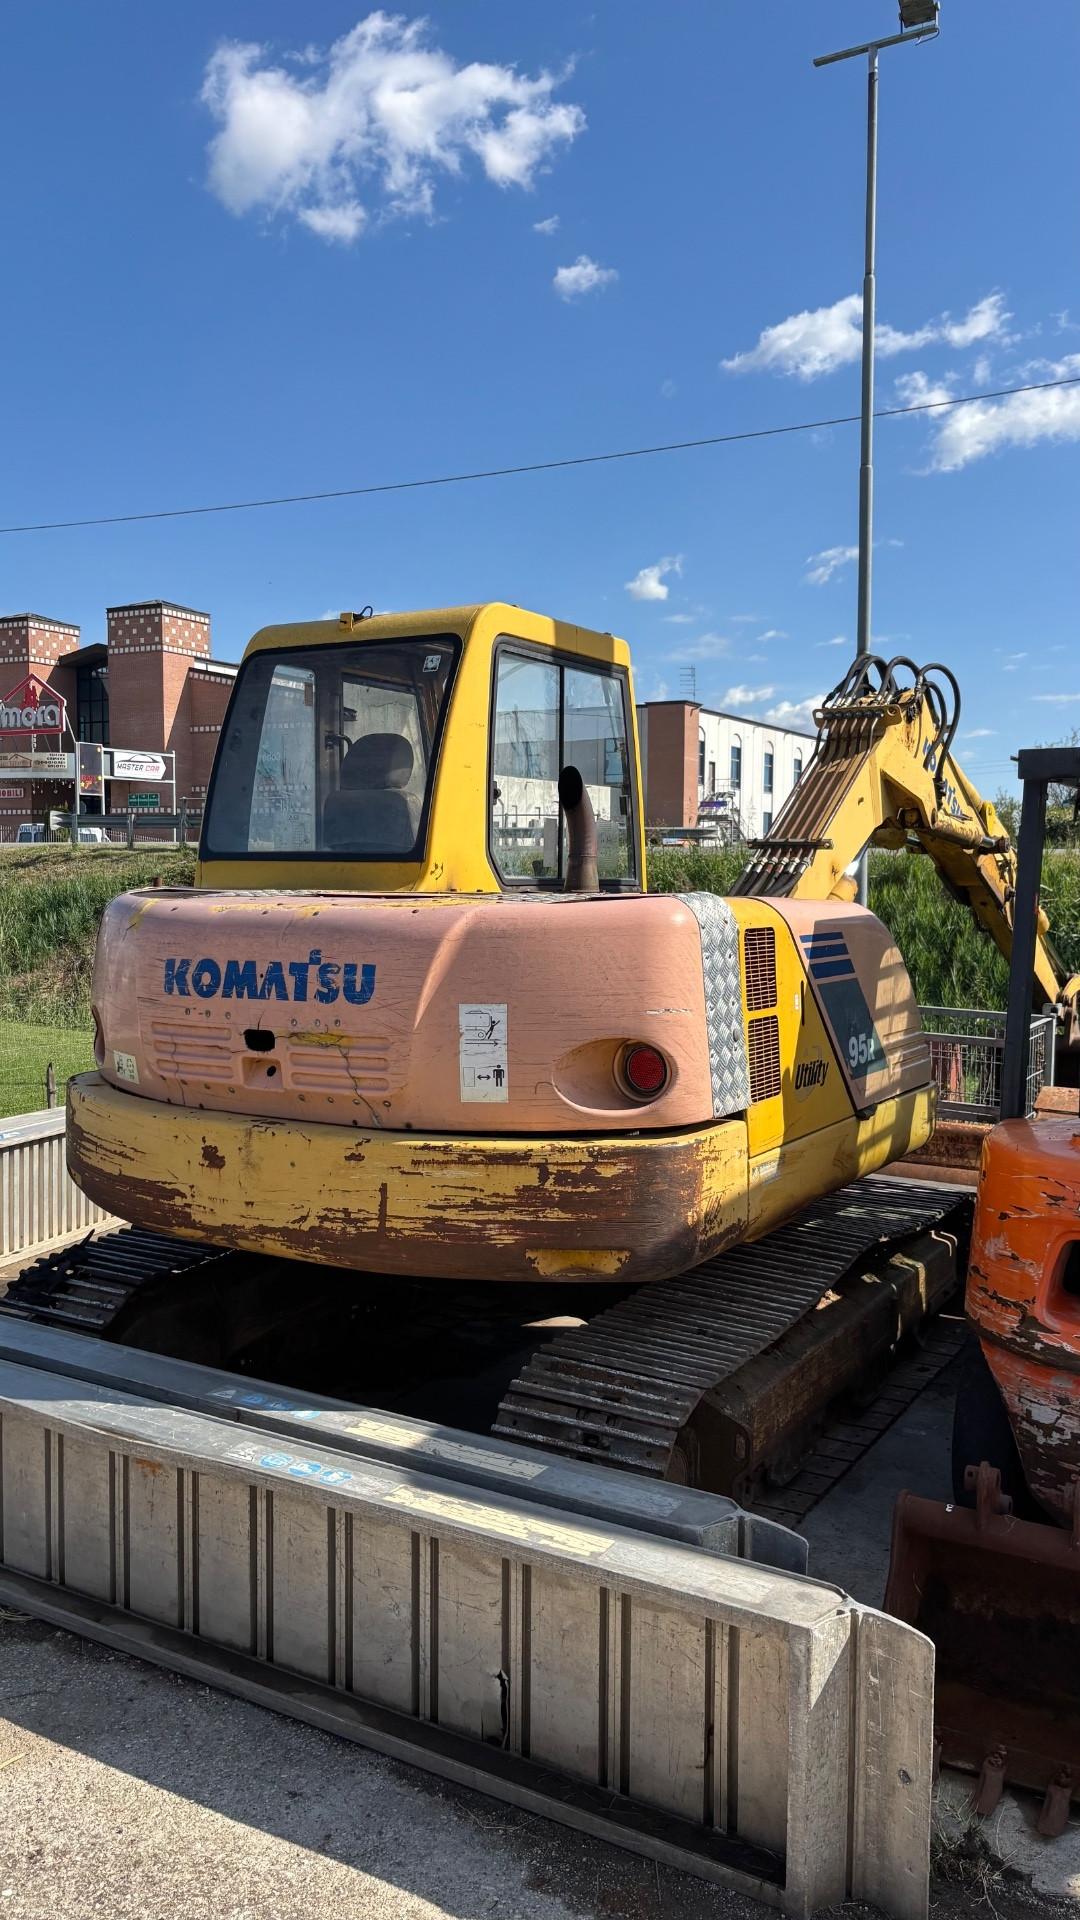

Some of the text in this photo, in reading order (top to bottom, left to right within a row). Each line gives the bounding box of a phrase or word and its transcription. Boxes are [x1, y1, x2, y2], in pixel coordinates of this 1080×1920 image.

[0, 704, 60, 728] mora
[116, 763, 161, 773] MASTER CAR
[164, 949, 377, 1005] KOMATSU
[794, 1059, 830, 1089] Utility
